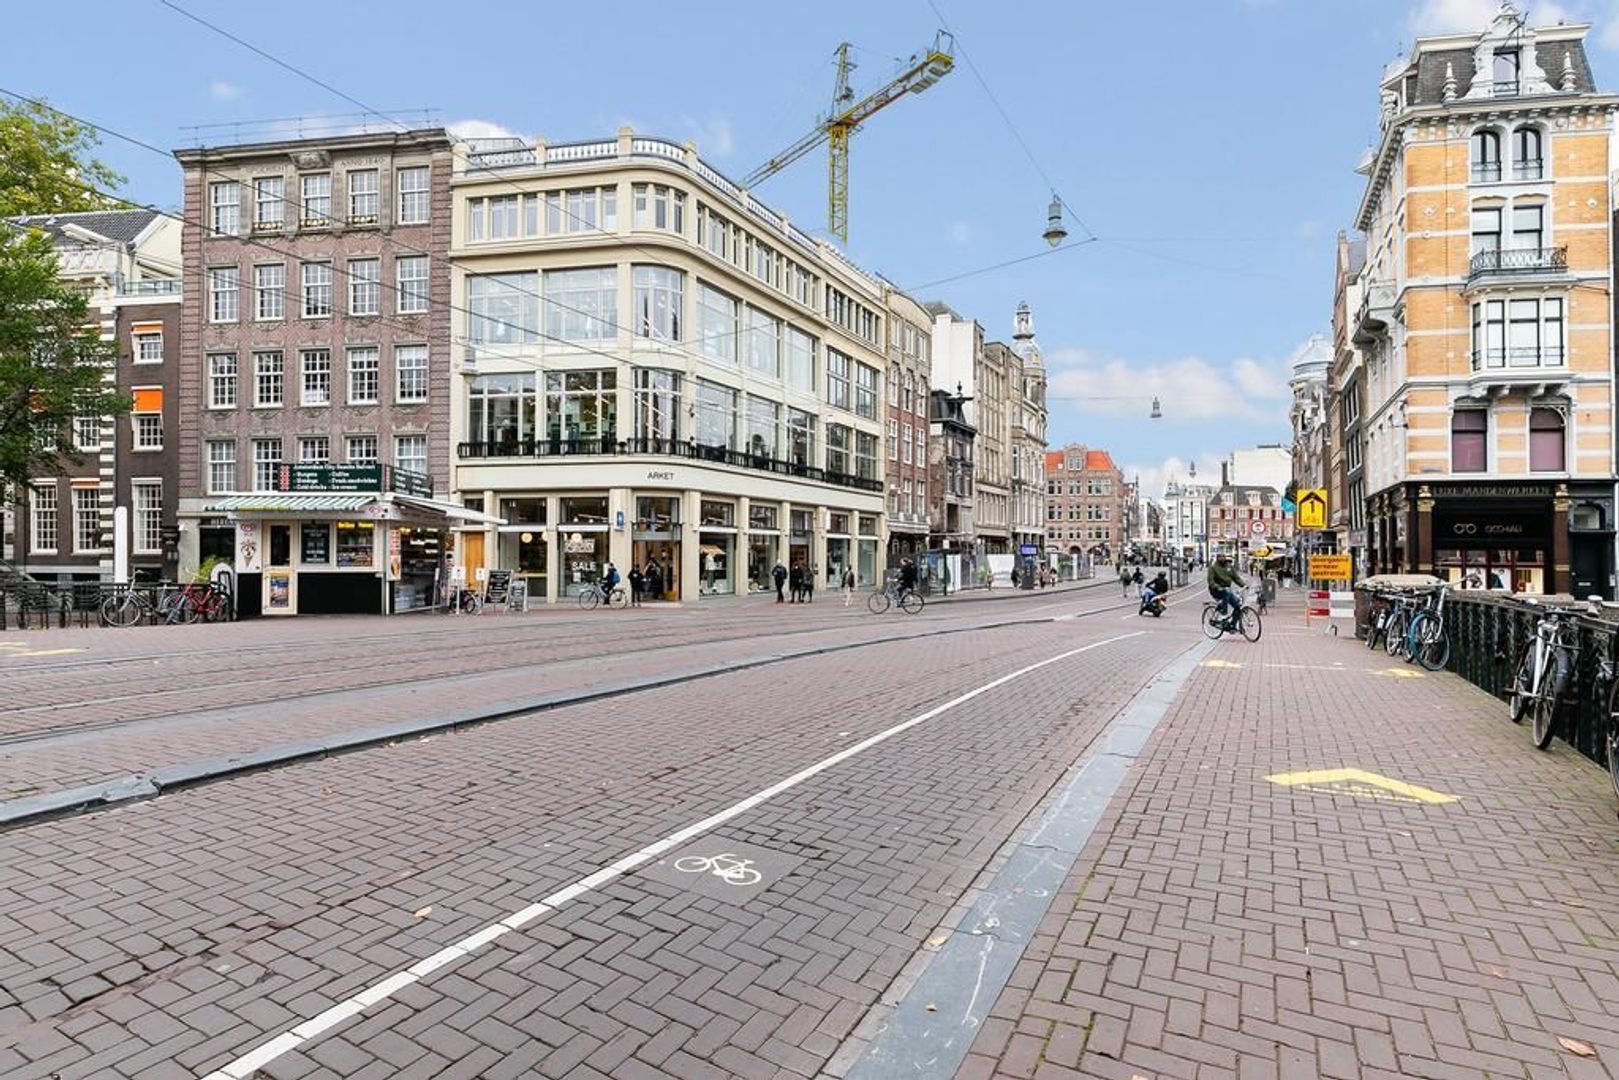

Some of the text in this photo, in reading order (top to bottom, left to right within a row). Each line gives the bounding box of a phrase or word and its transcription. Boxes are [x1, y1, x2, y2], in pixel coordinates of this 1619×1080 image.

[647, 471, 675, 481] ARKET
[1310, 500, 1316, 513] 1
[572, 561, 597, 572] SALE
